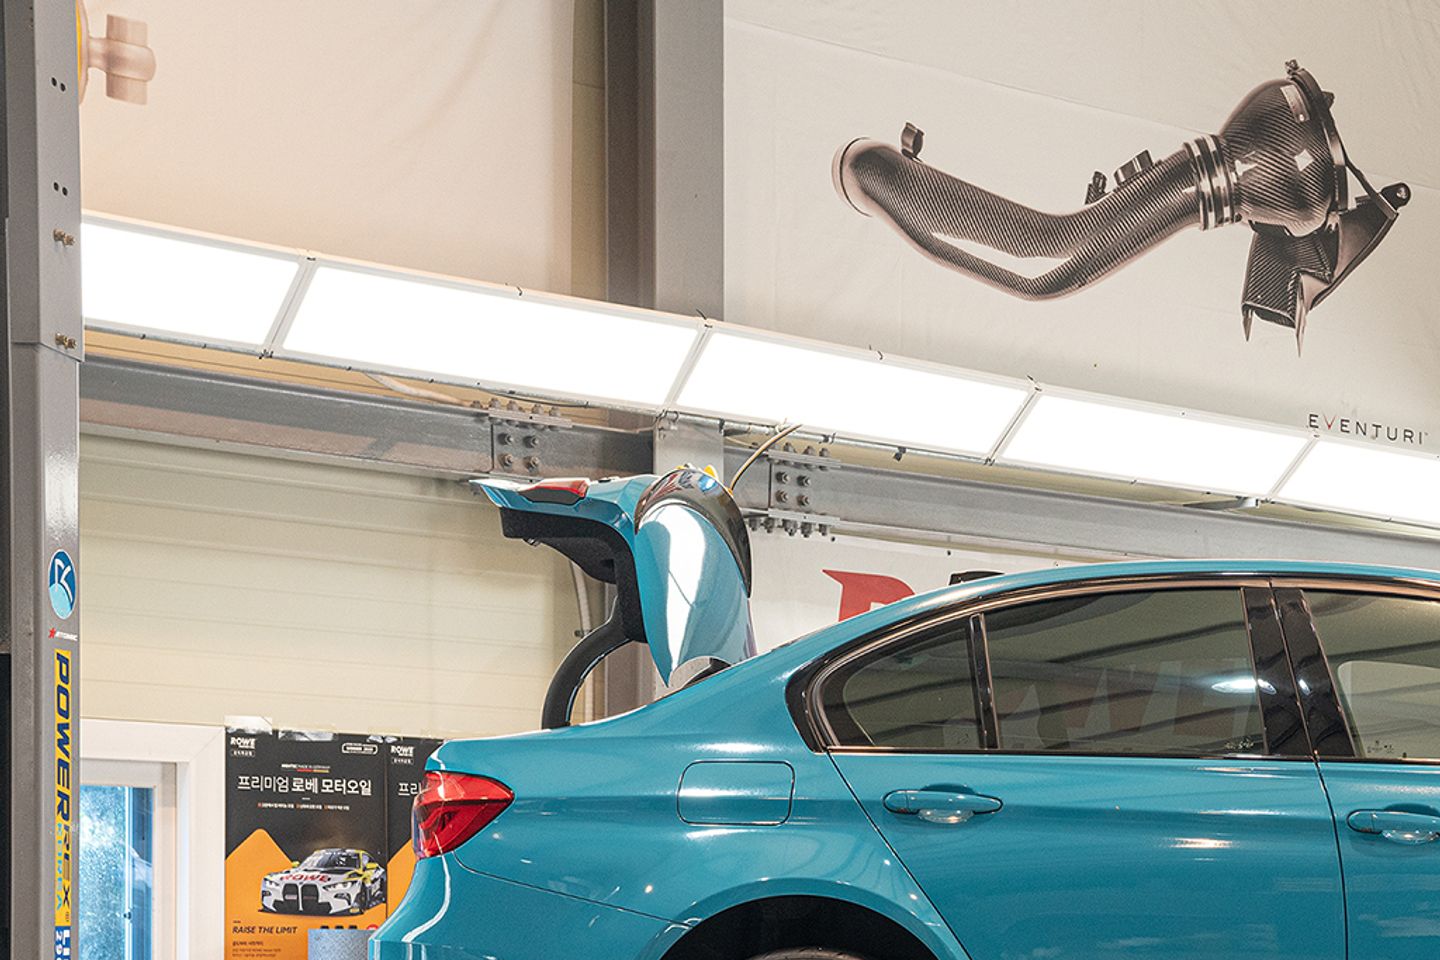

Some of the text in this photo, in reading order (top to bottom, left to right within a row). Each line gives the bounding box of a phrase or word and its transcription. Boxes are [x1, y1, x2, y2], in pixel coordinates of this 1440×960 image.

[1308, 413, 1423, 445] EVENTURI
[238, 776, 372, 796] 프리미엄 로베 모터오일
[232, 926, 298, 934] RAISE THE LIMIT
